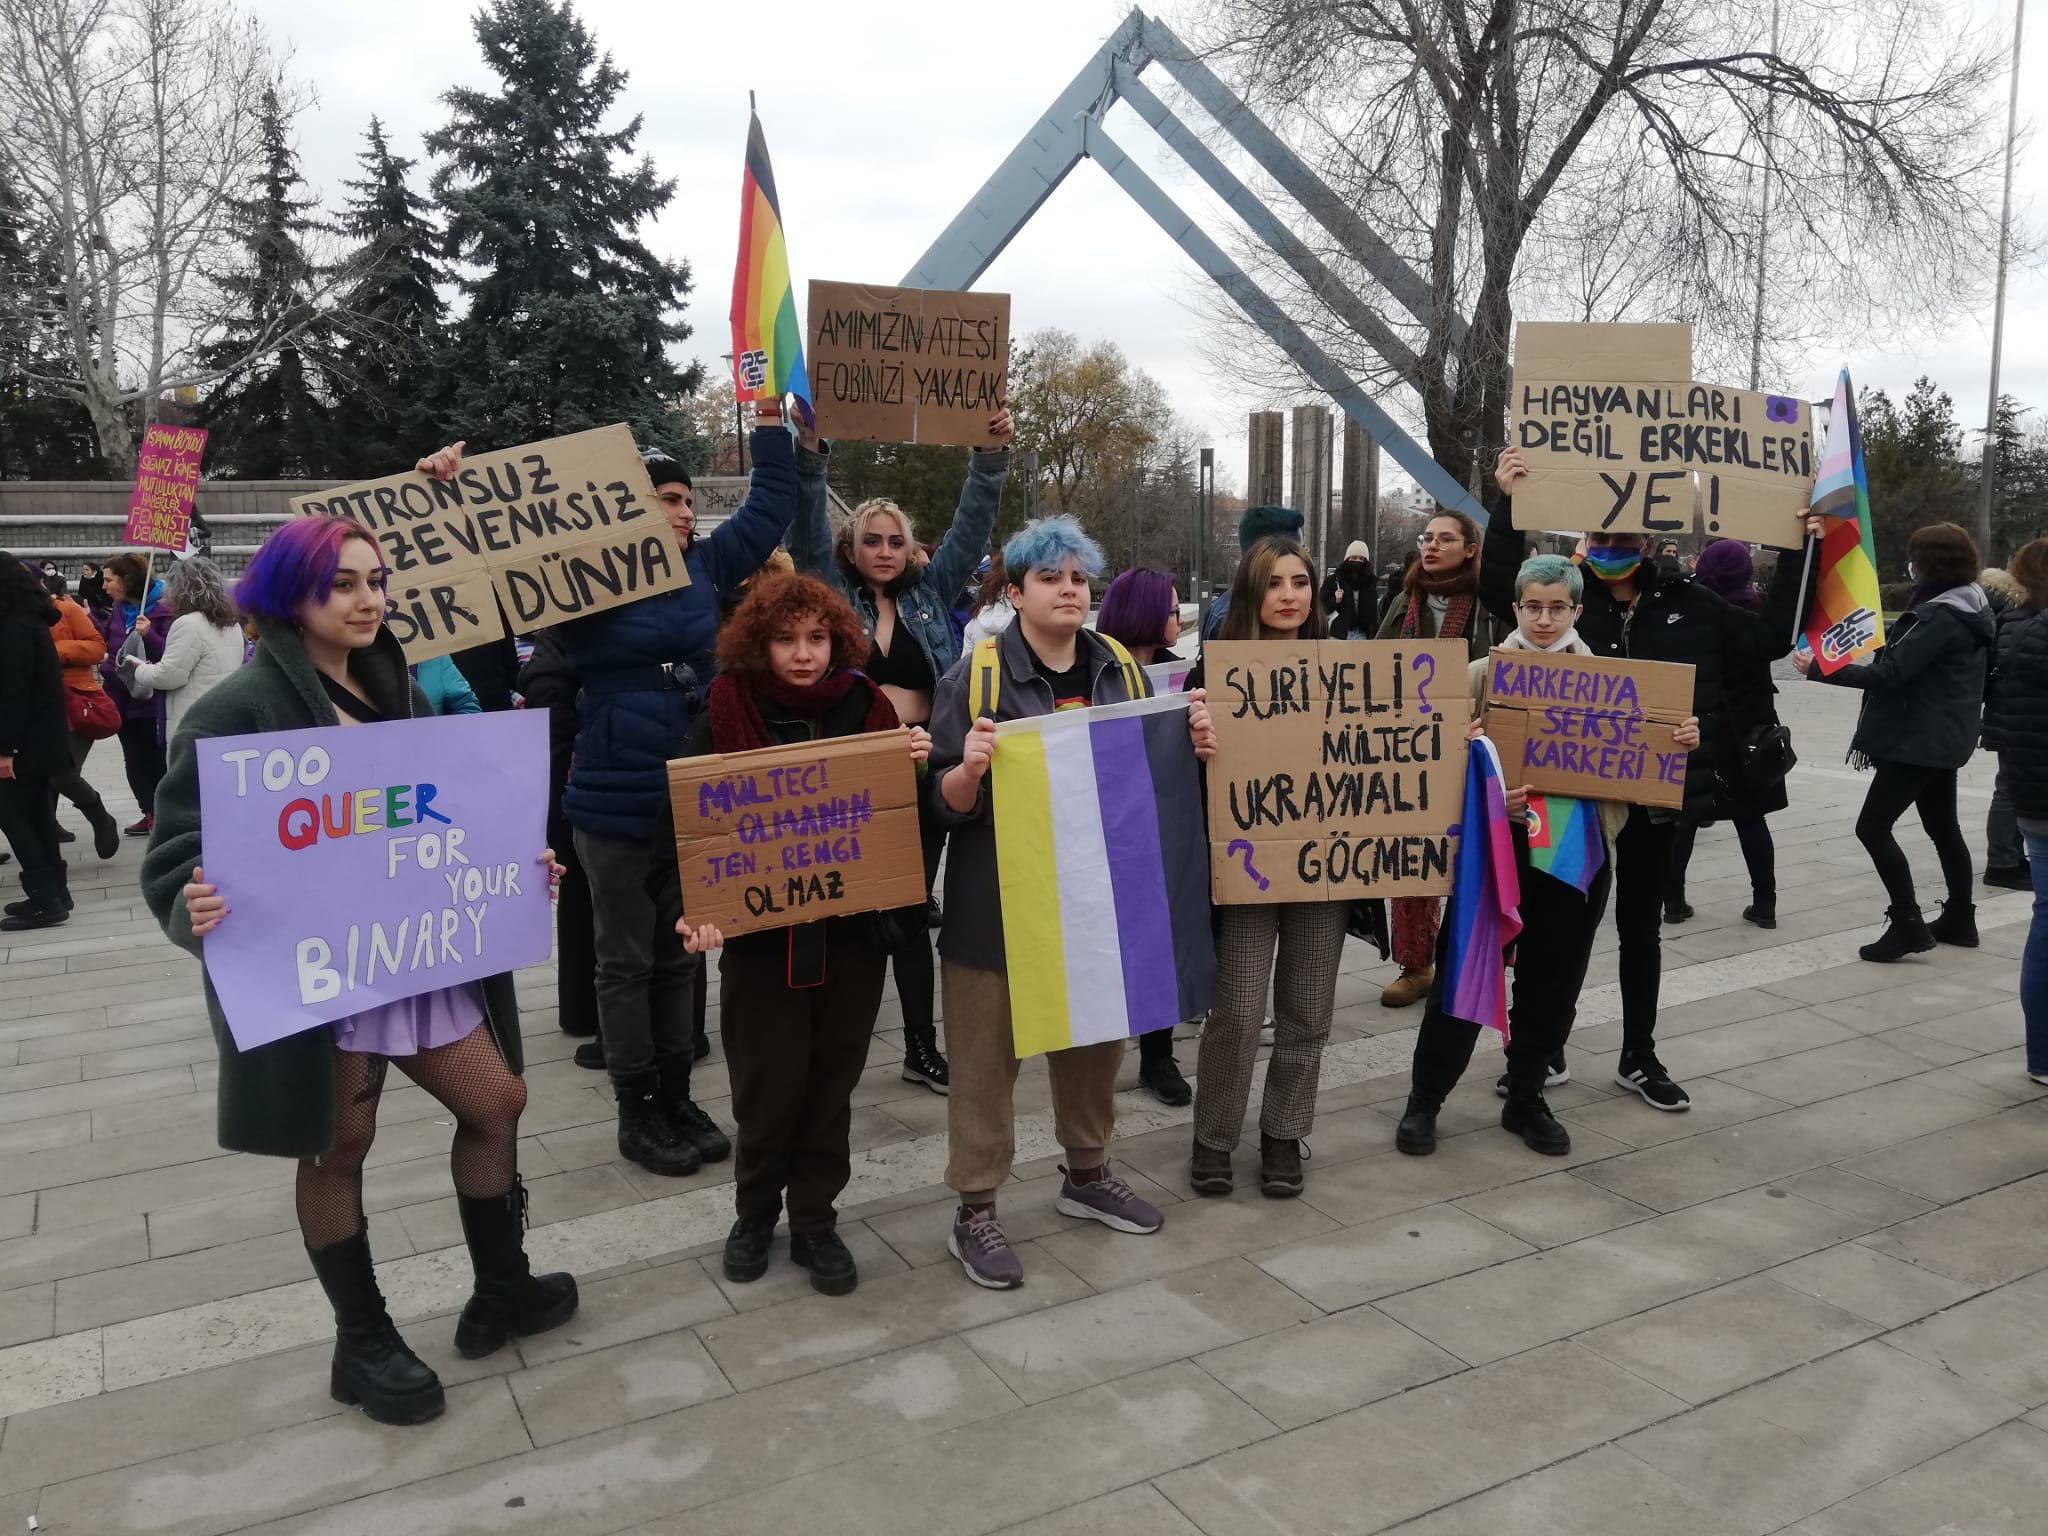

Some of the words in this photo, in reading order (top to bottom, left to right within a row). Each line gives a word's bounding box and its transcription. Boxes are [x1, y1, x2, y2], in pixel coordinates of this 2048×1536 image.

[928, 316, 998, 361] ATEŞİ
[816, 358, 904, 405] FOBİNİZİ
[914, 367, 1001, 411] YAKACAK
[1523, 385, 1740, 423] HAYVANLARI
[1519, 415, 1623, 460] DEĞİL
[1640, 424, 1810, 477] ERKEKLERİ
[385, 585, 480, 645] BİR
[505, 536, 672, 622] DÜNYA
[1492, 659, 1639, 709] KARKERIYA
[1322, 713, 1443, 766] MÜLTECİ
[1524, 737, 1649, 780] KARKERÎ
[1656, 752, 1687, 785] YE
[221, 746, 331, 798] TOO
[278, 783, 452, 851] QUEER
[735, 788, 873, 845] OLMANIN
[1229, 770, 1428, 831] UKRAYNALI
[387, 828, 470, 879] FOR
[1298, 831, 1448, 886] GÖÇMEN
[444, 862, 523, 906] YOUR
[744, 870, 844, 916] OLMAZ
[296, 902, 488, 1006] BINARY
